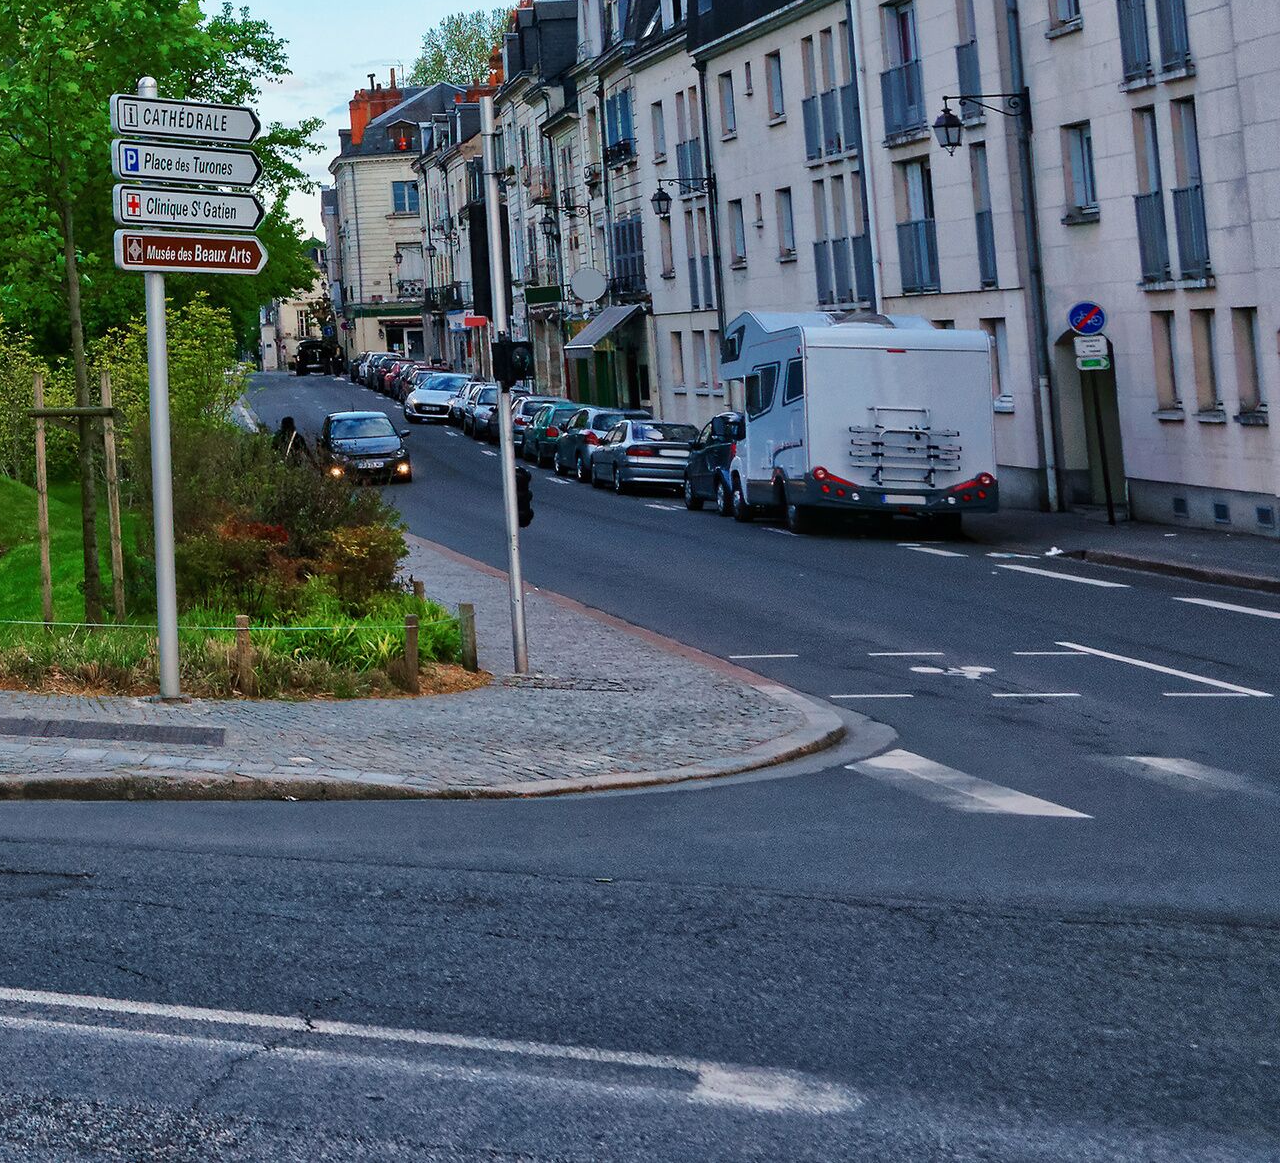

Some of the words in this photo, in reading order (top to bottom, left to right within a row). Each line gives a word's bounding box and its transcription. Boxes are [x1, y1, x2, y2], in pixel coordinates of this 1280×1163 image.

[143, 108, 227, 132] CATHÉDRALE
[144, 153, 172, 171] Place
[175, 158, 190, 172] des
[193, 156, 233, 176] Turones
[146, 197, 188, 220] Clinique
[203, 202, 237, 220] Gatien
[146, 245, 175, 260] Musée
[177, 247, 193, 262] des
[194, 244, 226, 263] Beaux
[229, 246, 252, 264] Arts
